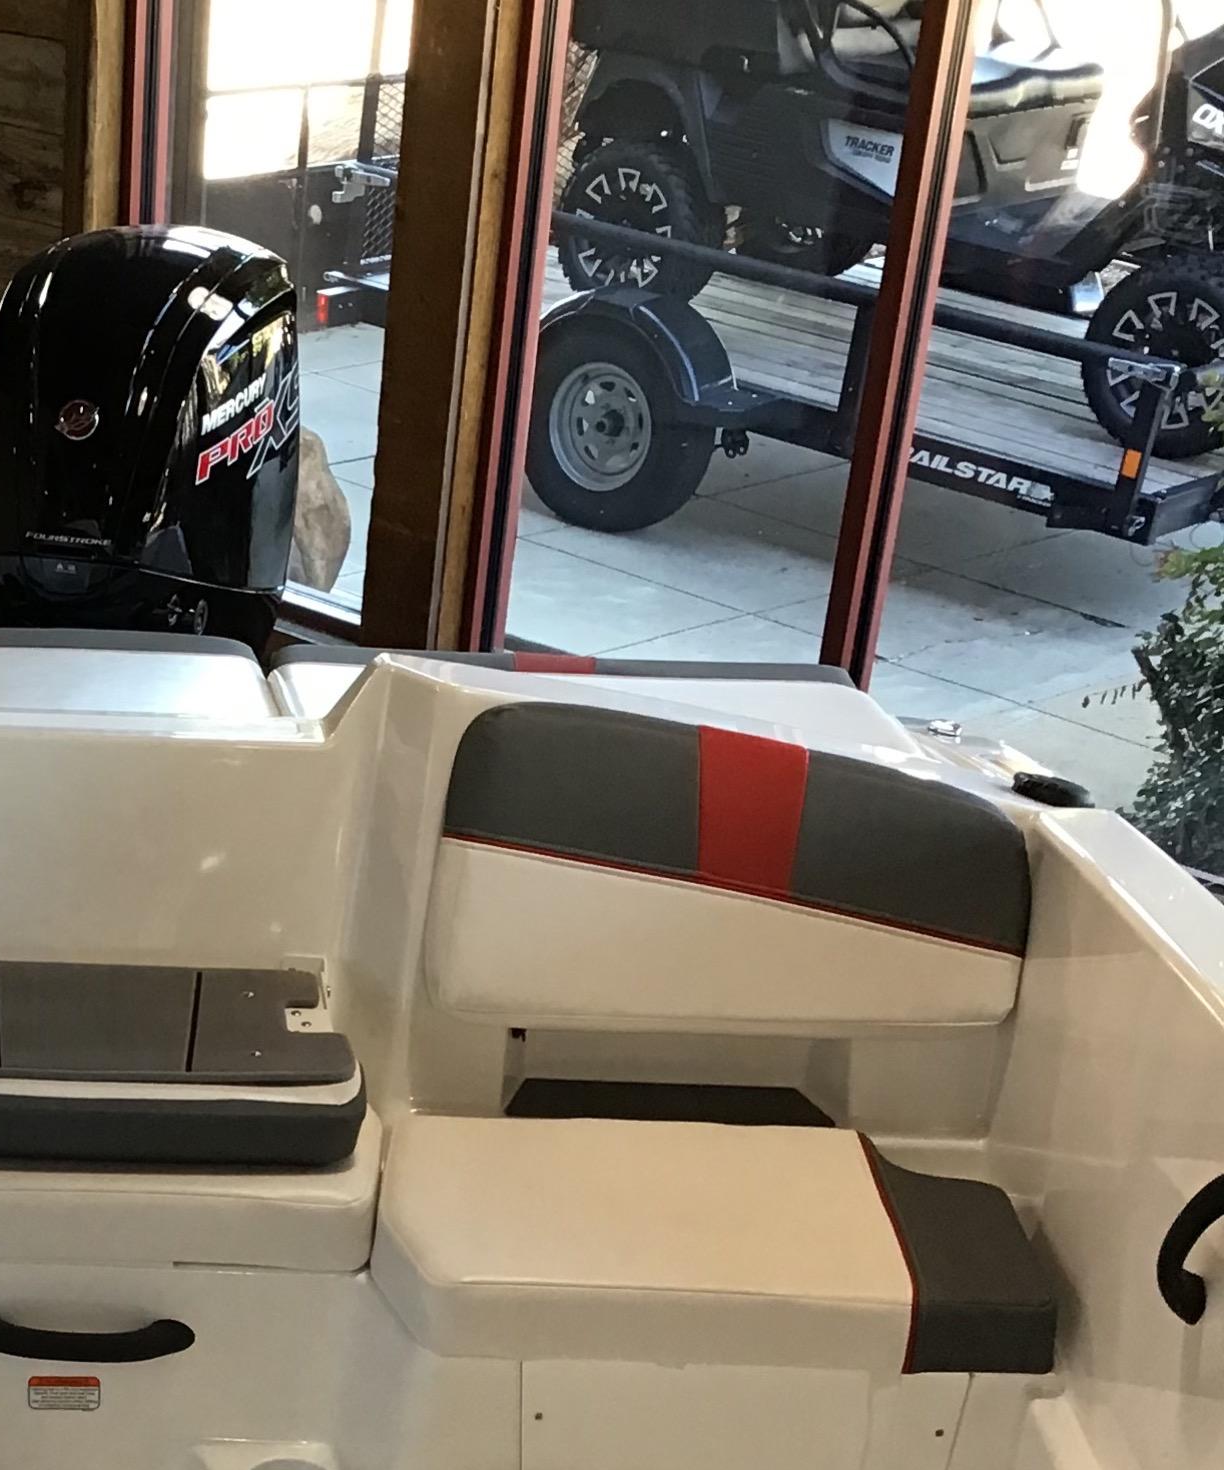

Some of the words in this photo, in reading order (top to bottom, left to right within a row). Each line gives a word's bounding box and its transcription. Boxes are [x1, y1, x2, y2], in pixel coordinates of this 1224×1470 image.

[844, 135, 895, 157] TRACKER
[201, 372, 267, 436] MERCURY
[908, 446, 1033, 497] AILSTAR
